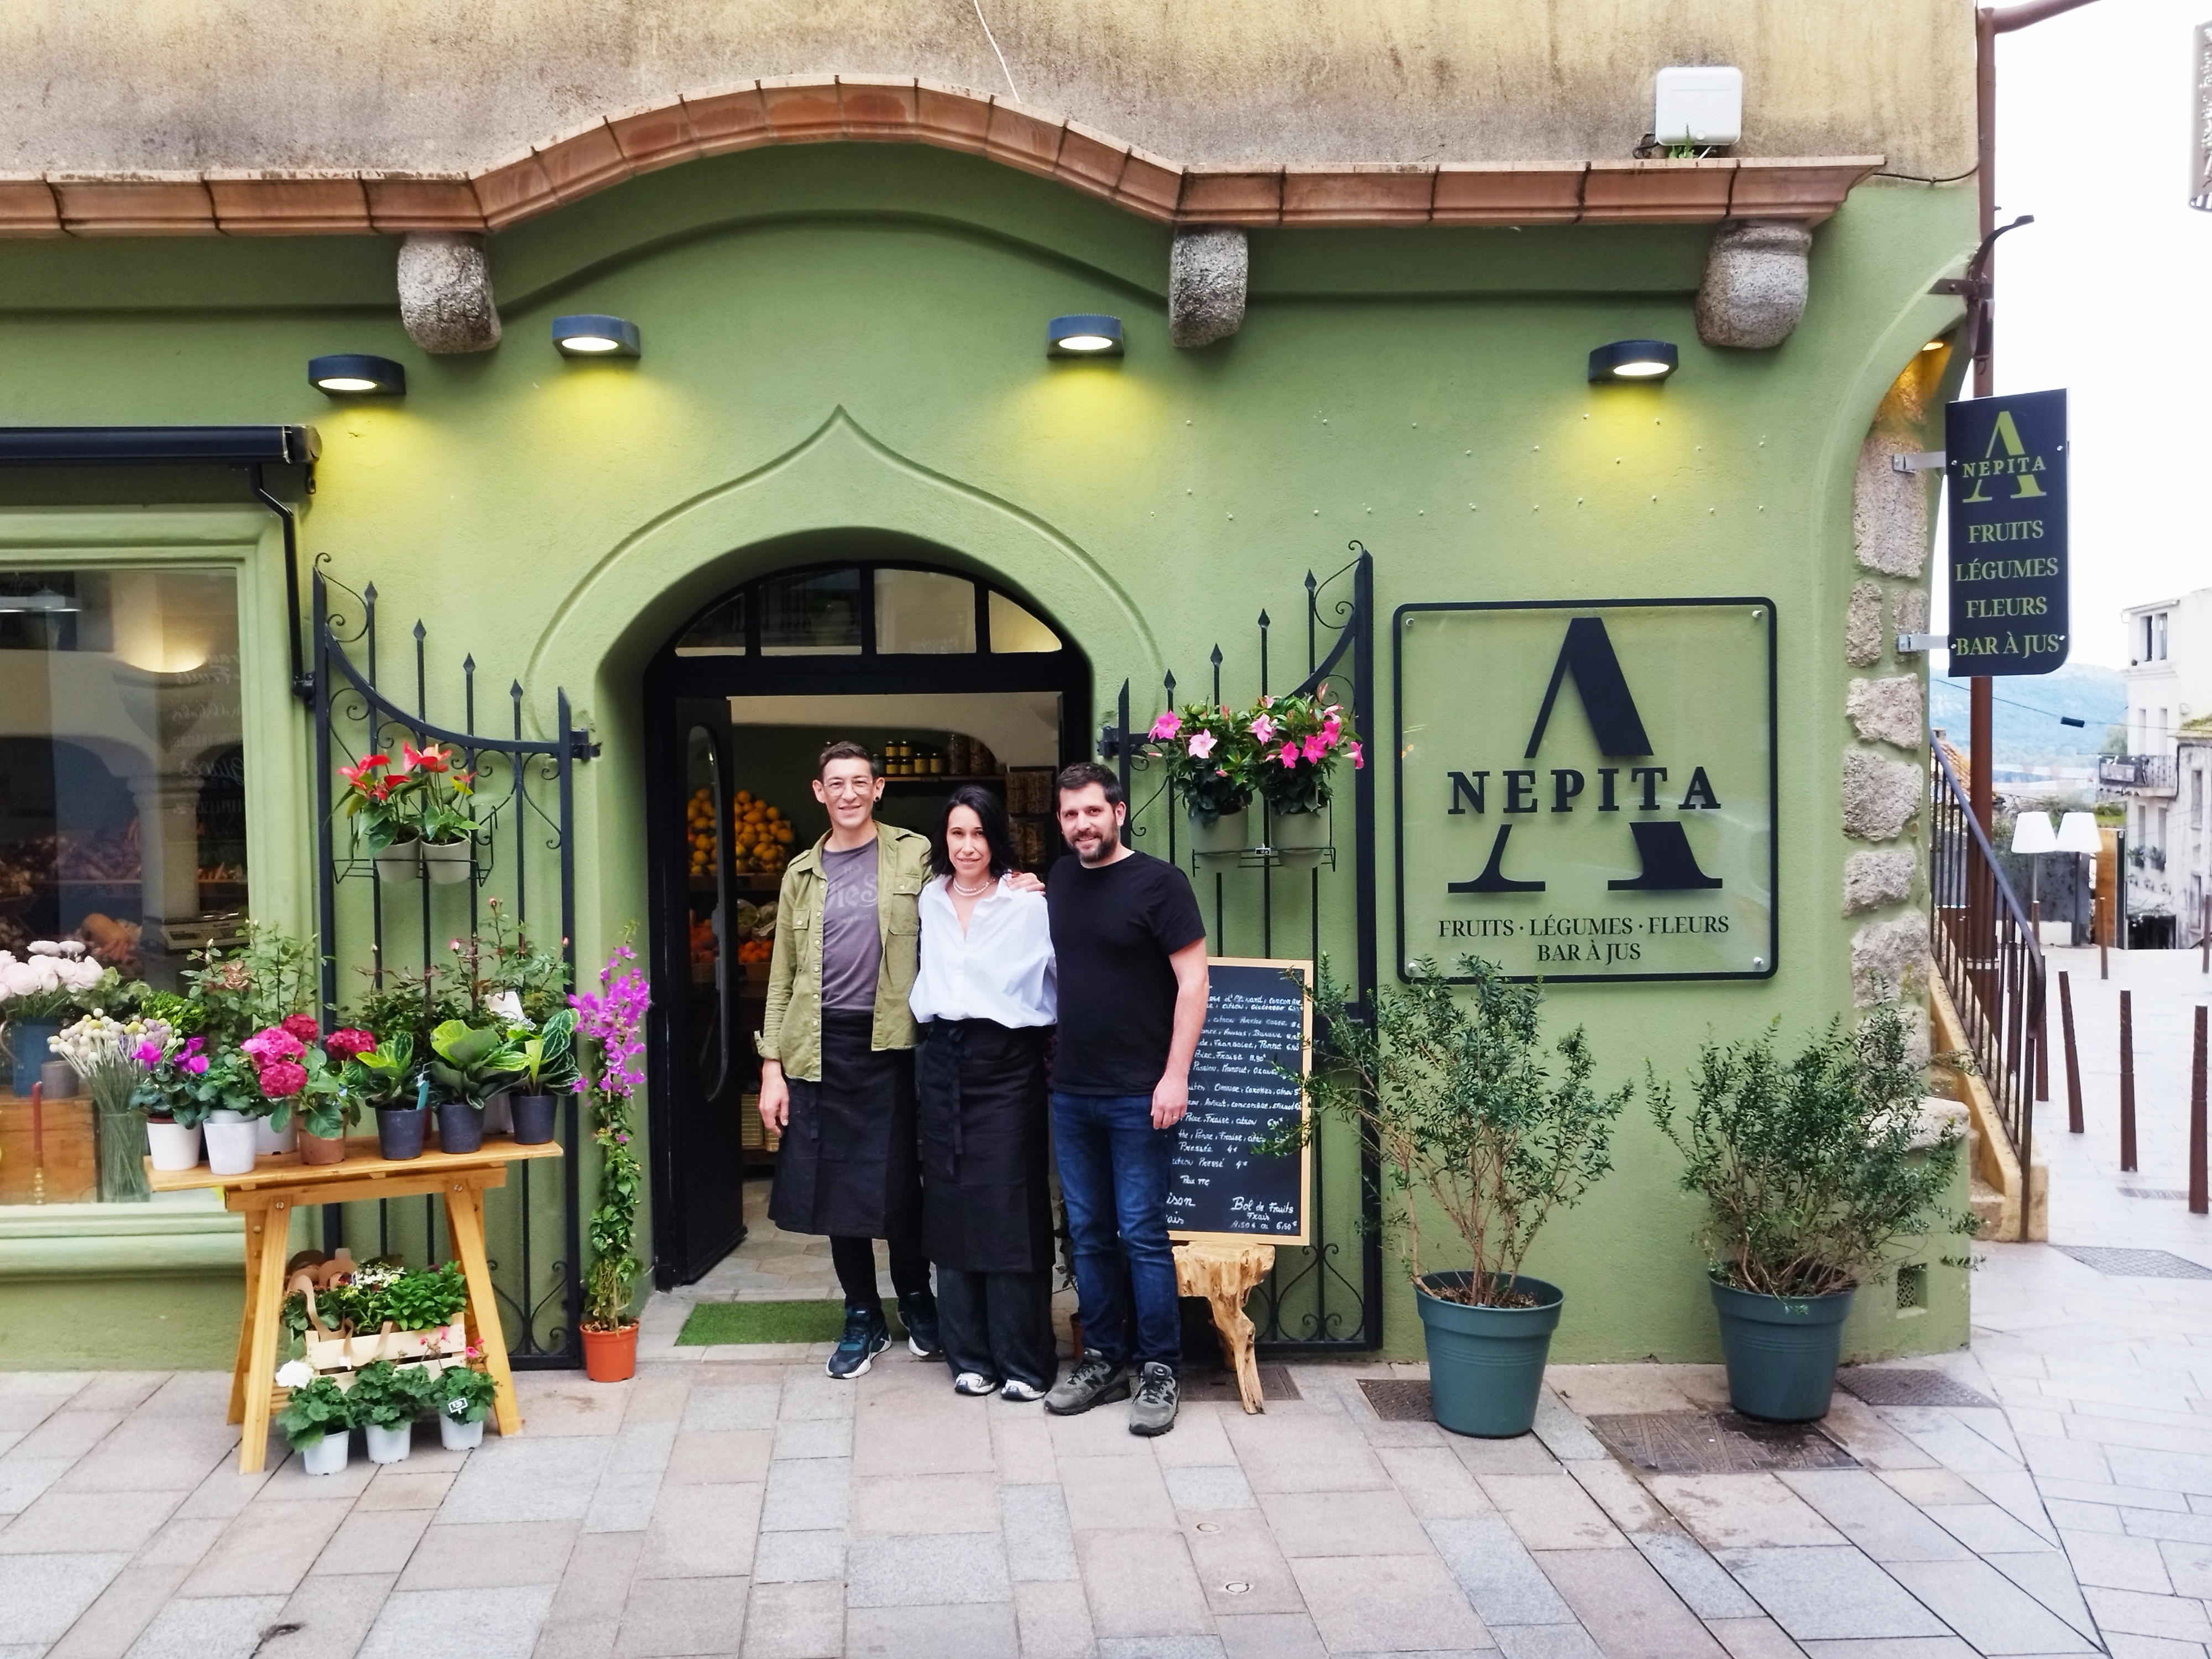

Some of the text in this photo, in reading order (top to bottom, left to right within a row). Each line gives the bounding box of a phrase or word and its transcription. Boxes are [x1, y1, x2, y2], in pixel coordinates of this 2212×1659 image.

[1963, 456, 2046, 478] NEPITA
[1968, 520, 2044, 544] FRUITS
[1955, 558, 2058, 582] LÉGUMES
[1966, 596, 2048, 618] FLEURS
[1956, 632, 2060, 659] BAR À JUS
[1447, 766, 1721, 815] NEPITA
[1438, 914, 1730, 938] FRUITS LÉGUMES FLEURS
[1537, 939, 1641, 965] BAR À JUS
[1166, 1192, 1196, 1207] ison
[1230, 1196, 1254, 1211] Bol
[1255, 1201, 1264, 1212] de
[1165, 1211, 1184, 1224] ais
